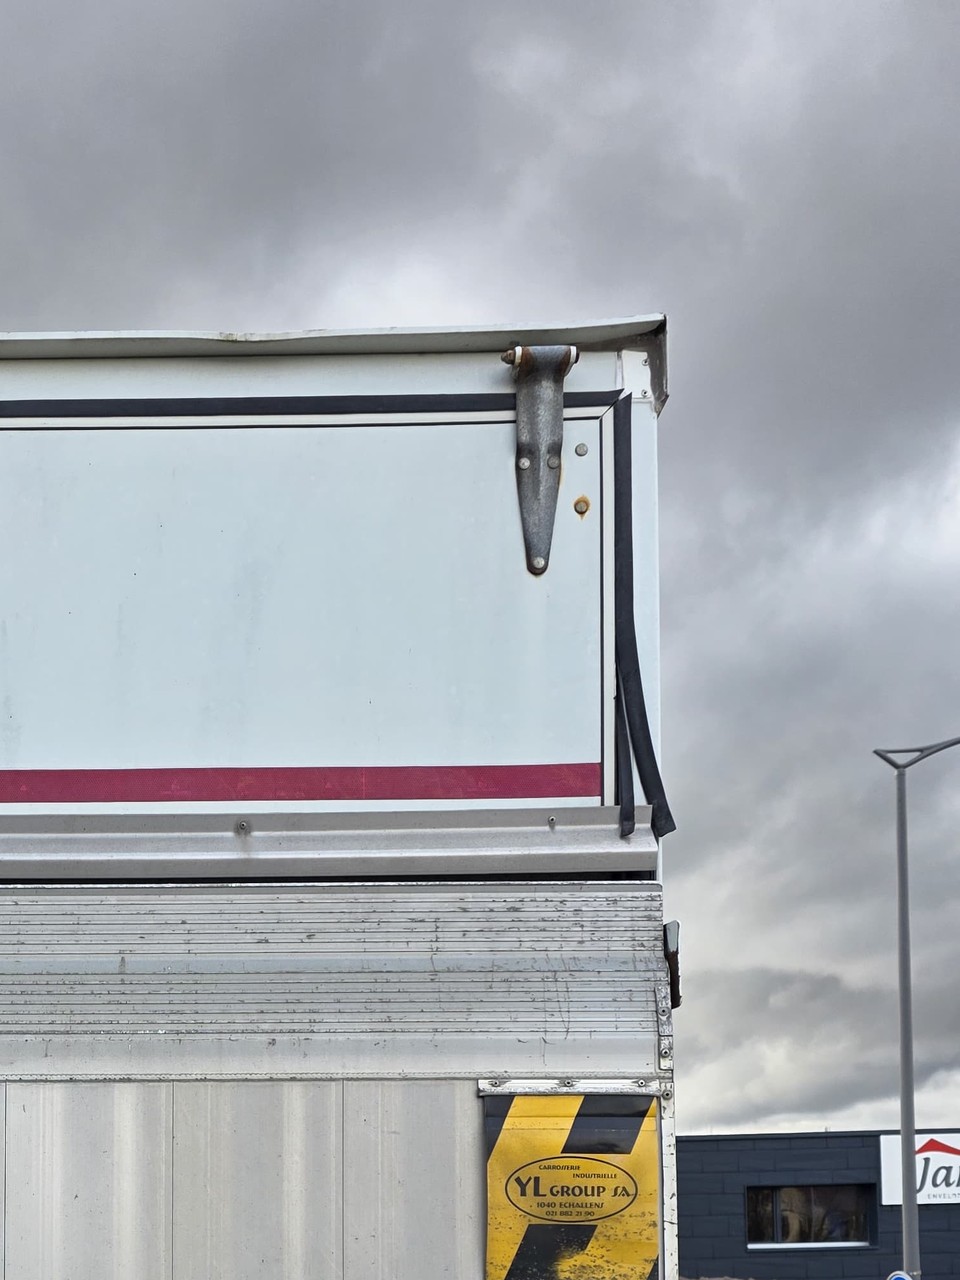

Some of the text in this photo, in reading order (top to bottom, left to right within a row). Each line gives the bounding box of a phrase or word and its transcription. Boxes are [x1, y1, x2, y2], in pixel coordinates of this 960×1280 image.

[514, 1176, 631, 1198] YL GROUP SA
[916, 1157, 960, 1193] Ja
